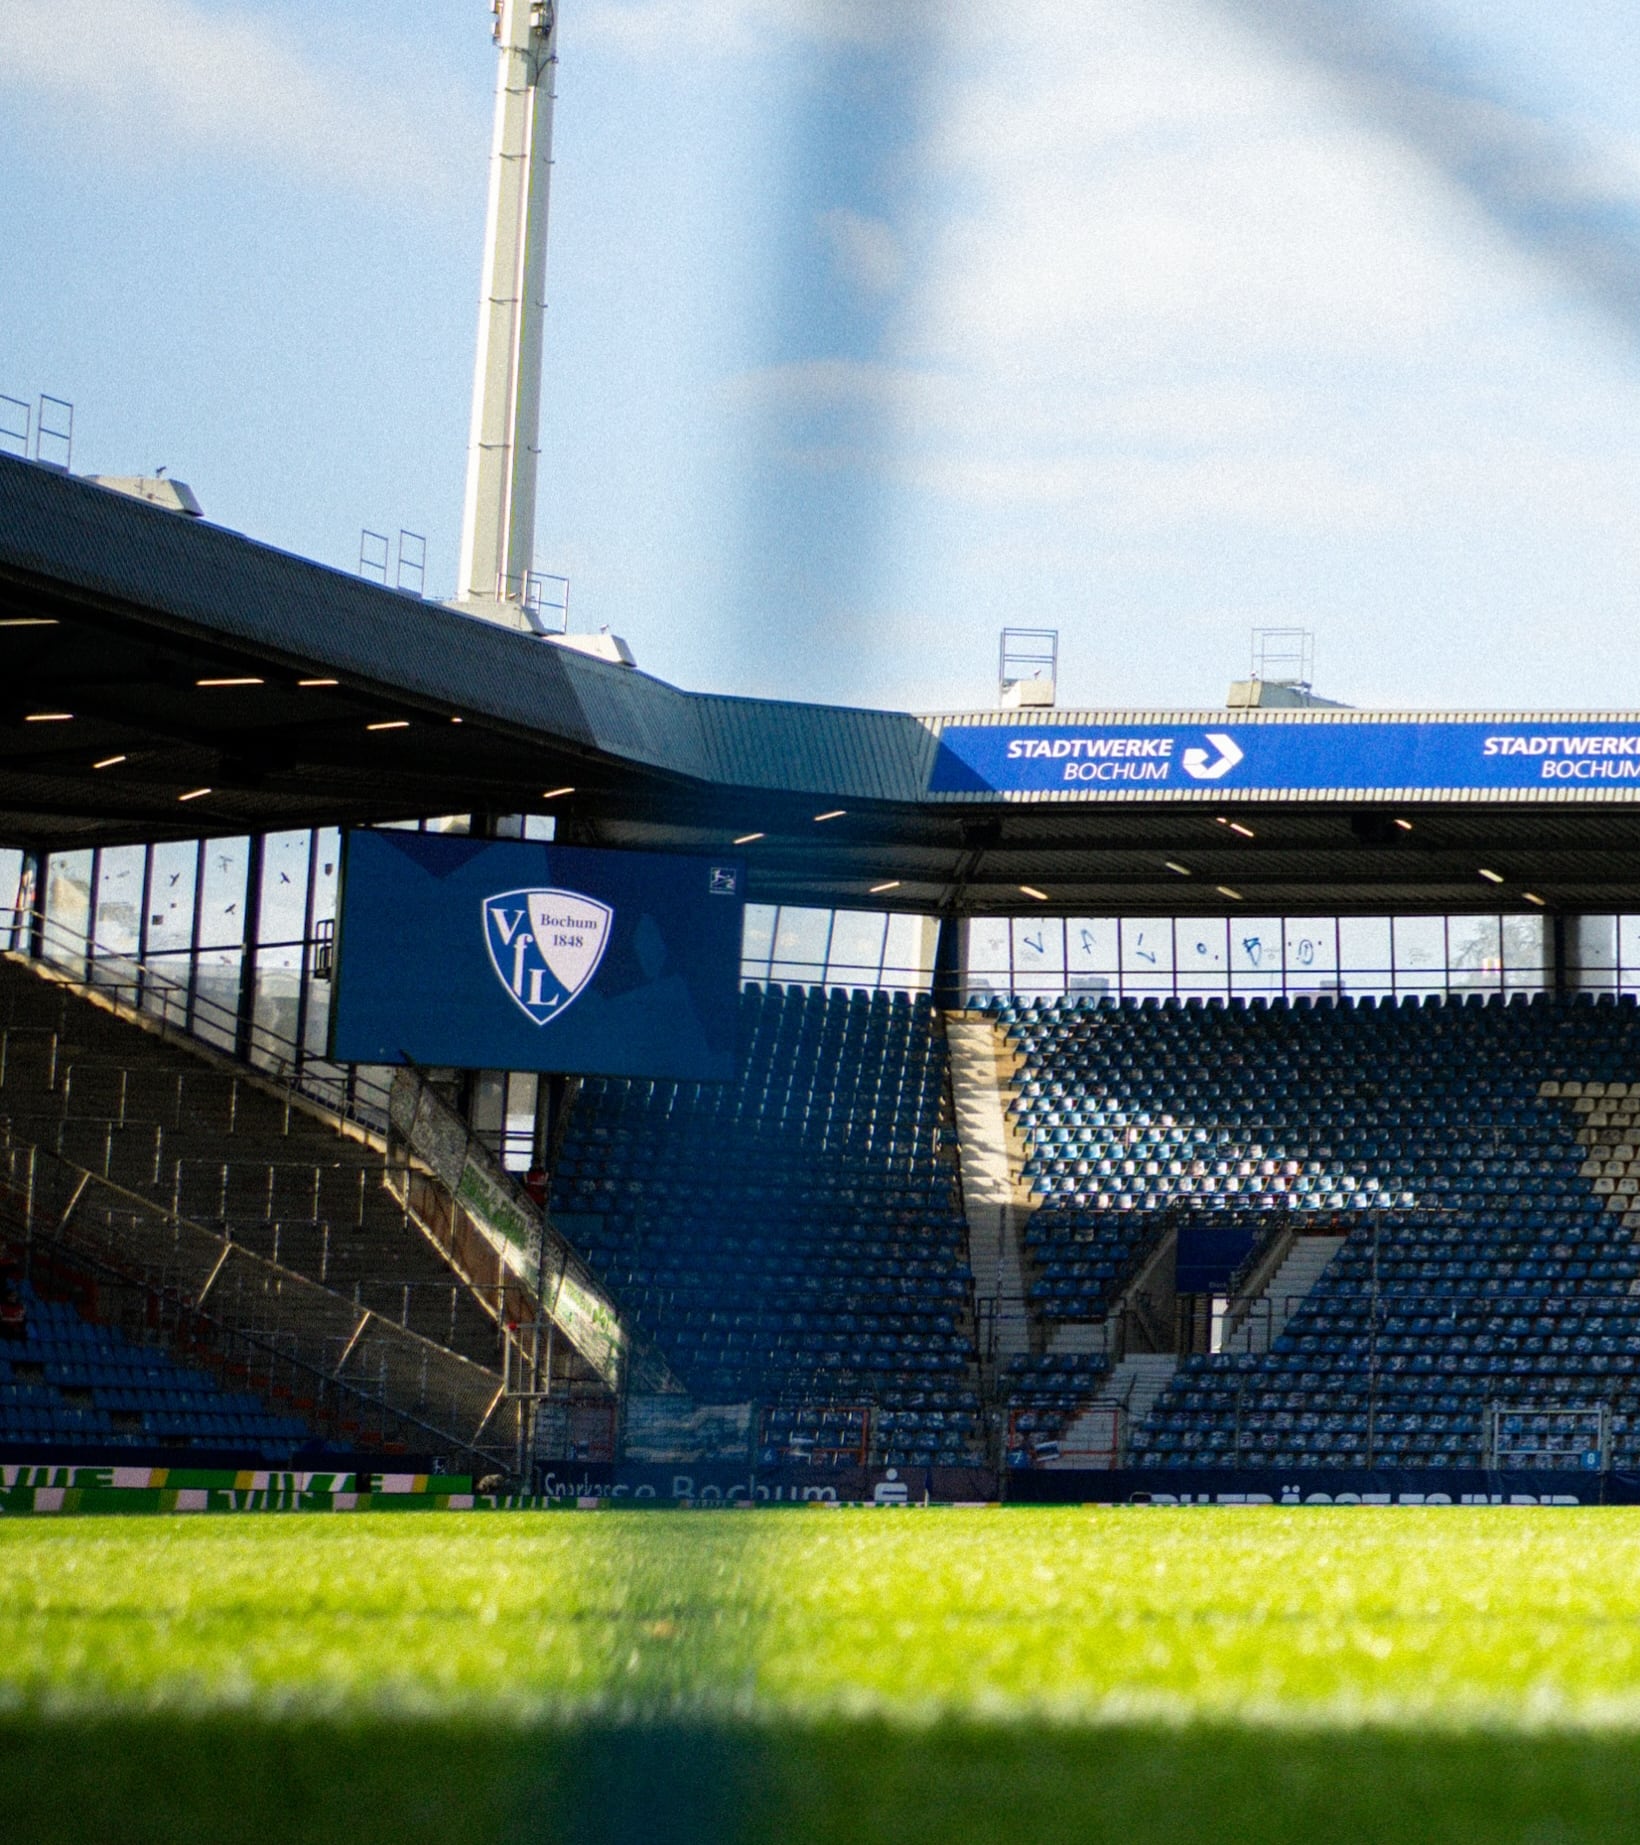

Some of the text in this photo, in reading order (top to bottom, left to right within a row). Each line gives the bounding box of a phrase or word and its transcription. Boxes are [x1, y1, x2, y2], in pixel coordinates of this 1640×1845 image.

[1007, 739, 1173, 759] STADTWERKE
[1064, 761, 1170, 781] BOCHUM
[540, 913, 598, 930] Bochum
[553, 934, 584, 948] 1848
